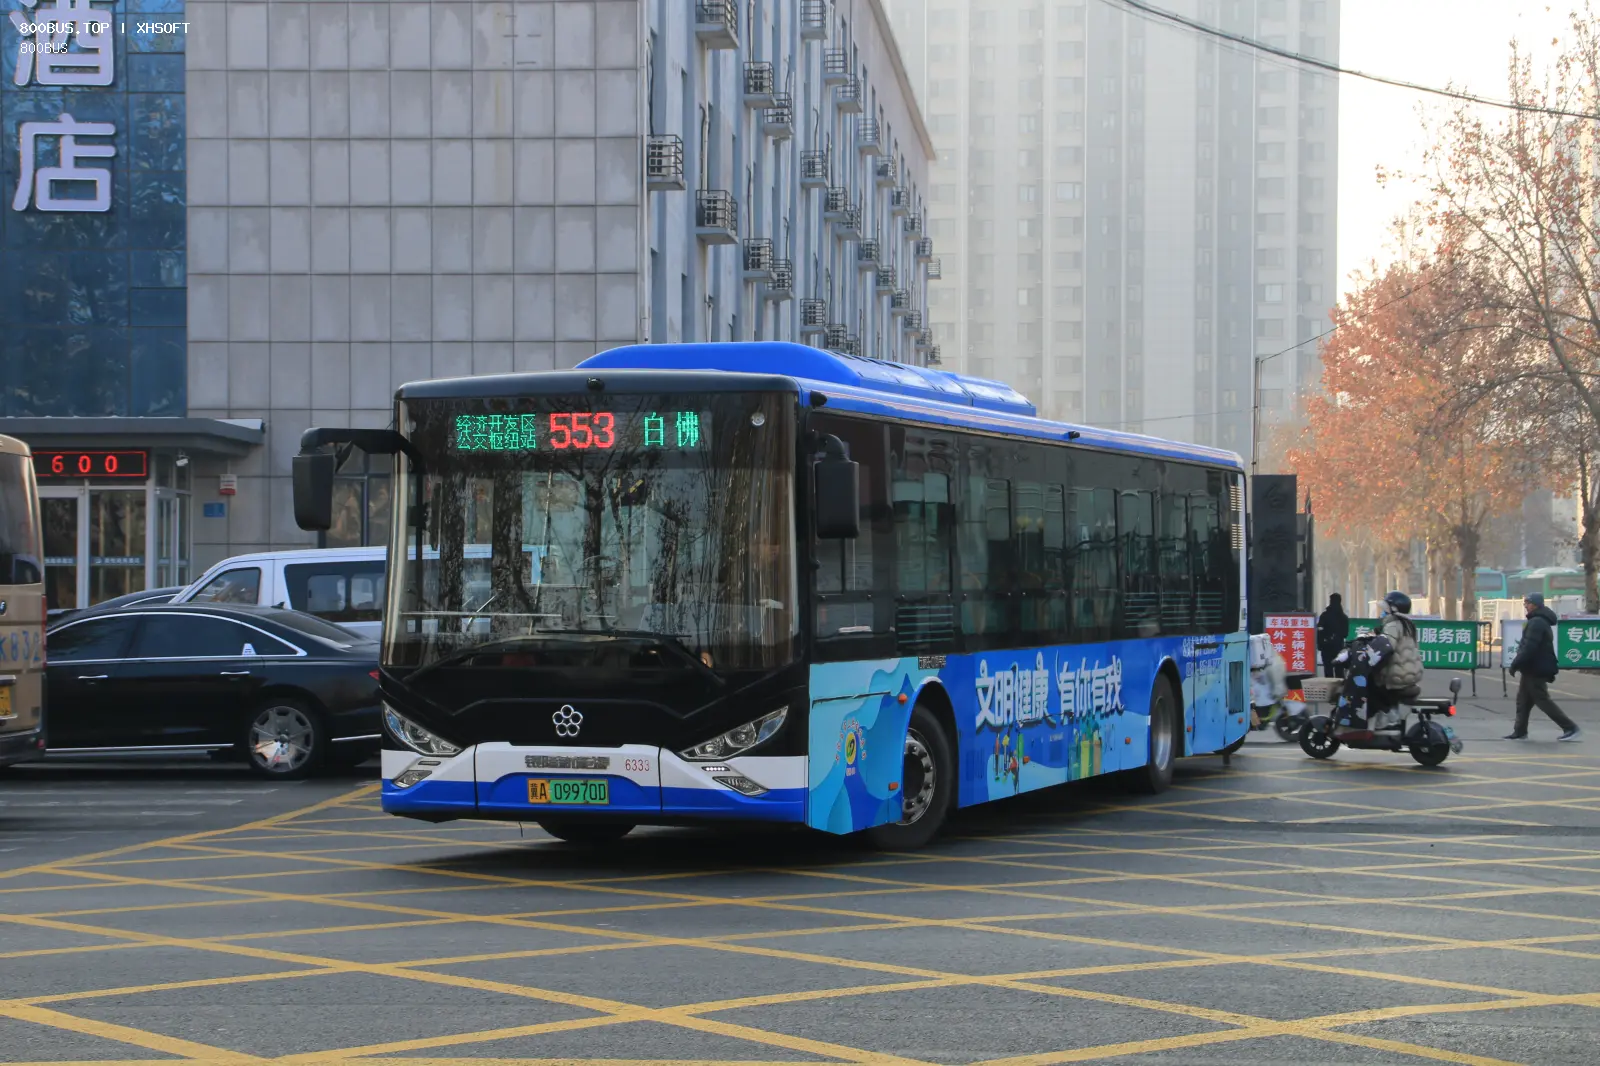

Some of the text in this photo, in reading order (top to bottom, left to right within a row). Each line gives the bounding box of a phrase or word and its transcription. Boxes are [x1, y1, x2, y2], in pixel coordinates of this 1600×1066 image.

[456, 413, 536, 432] 经济开发区
[550, 411, 615, 449] 553
[456, 431, 536, 450] 公交枢纽站
[975, 651, 1125, 729] 文明健康 有你有我
[625, 758, 650, 772] 6333
